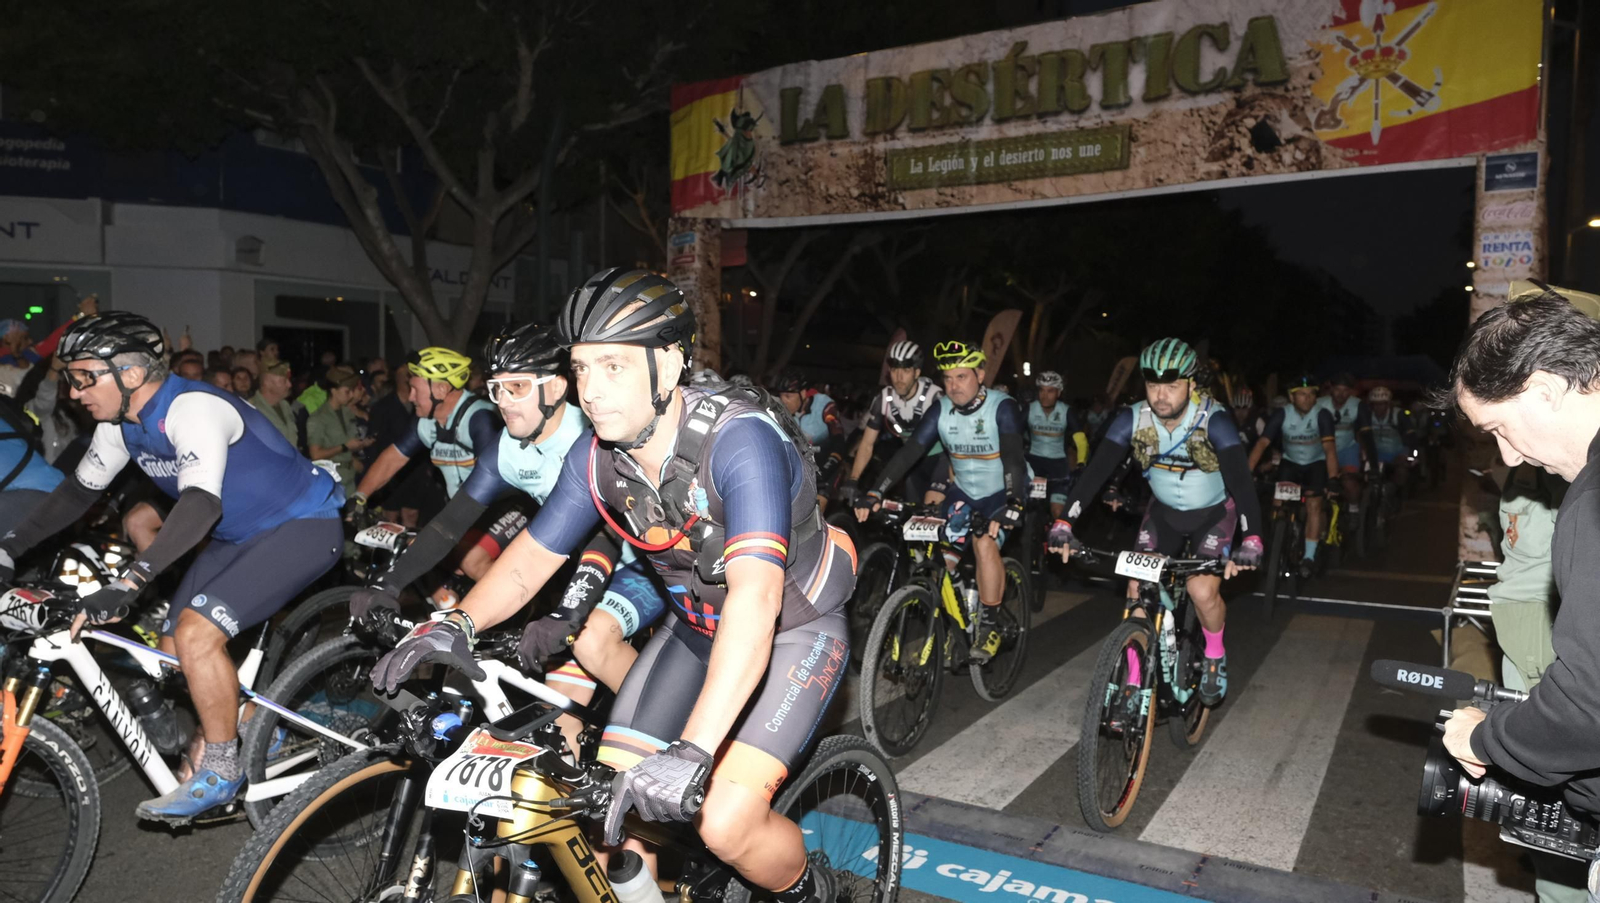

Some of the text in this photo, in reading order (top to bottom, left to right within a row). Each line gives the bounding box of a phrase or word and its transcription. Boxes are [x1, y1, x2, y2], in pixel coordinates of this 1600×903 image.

[779, 14, 1289, 145] LA DESÉRTICA
[909, 144, 1102, 176] La Legión y el desierto nos une
[1482, 241, 1533, 254] RENTA
[505, 526, 519, 540] DEL
[1126, 552, 1161, 569] 8858
[1396, 668, 1444, 690] RØDE
[765, 681, 803, 733] Comercial
[796, 669, 810, 682] de
[92, 684, 151, 768] CANYON
[445, 754, 513, 792] 7678
[887, 831, 900, 893] MEZCAL
